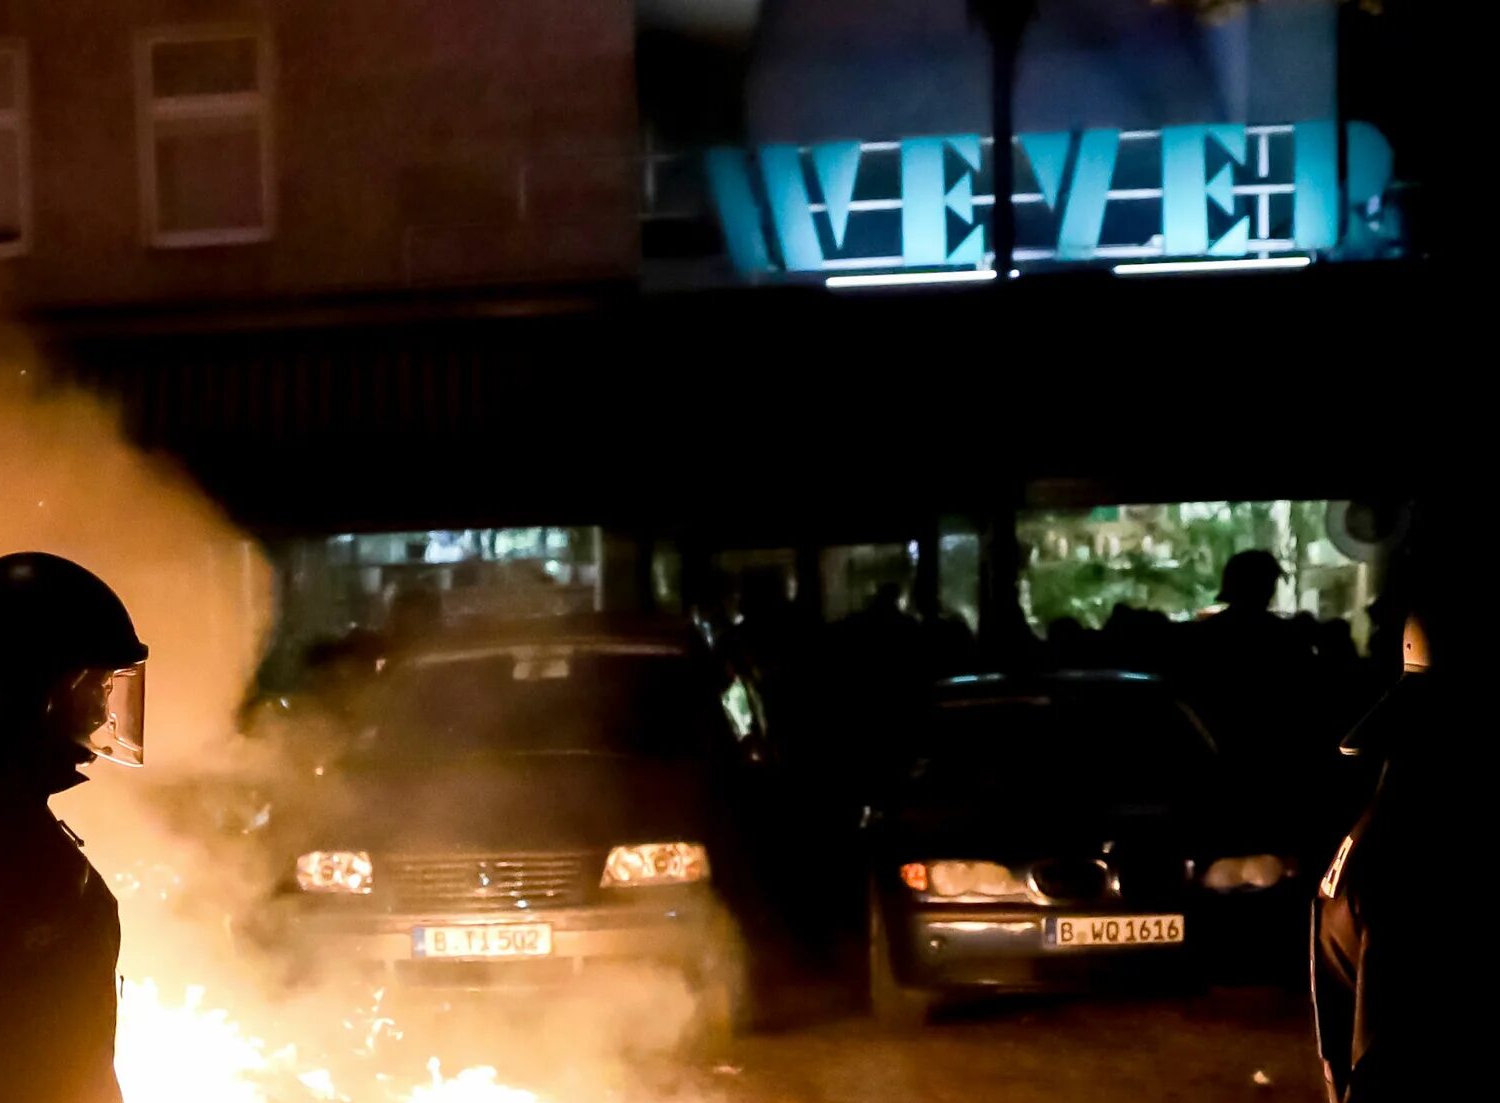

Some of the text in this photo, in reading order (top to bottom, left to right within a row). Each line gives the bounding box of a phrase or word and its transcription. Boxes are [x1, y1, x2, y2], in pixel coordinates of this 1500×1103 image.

[434, 930, 446, 952] B
[498, 928, 539, 951] 502
[1060, 919, 1180, 942] B WQ 1616
